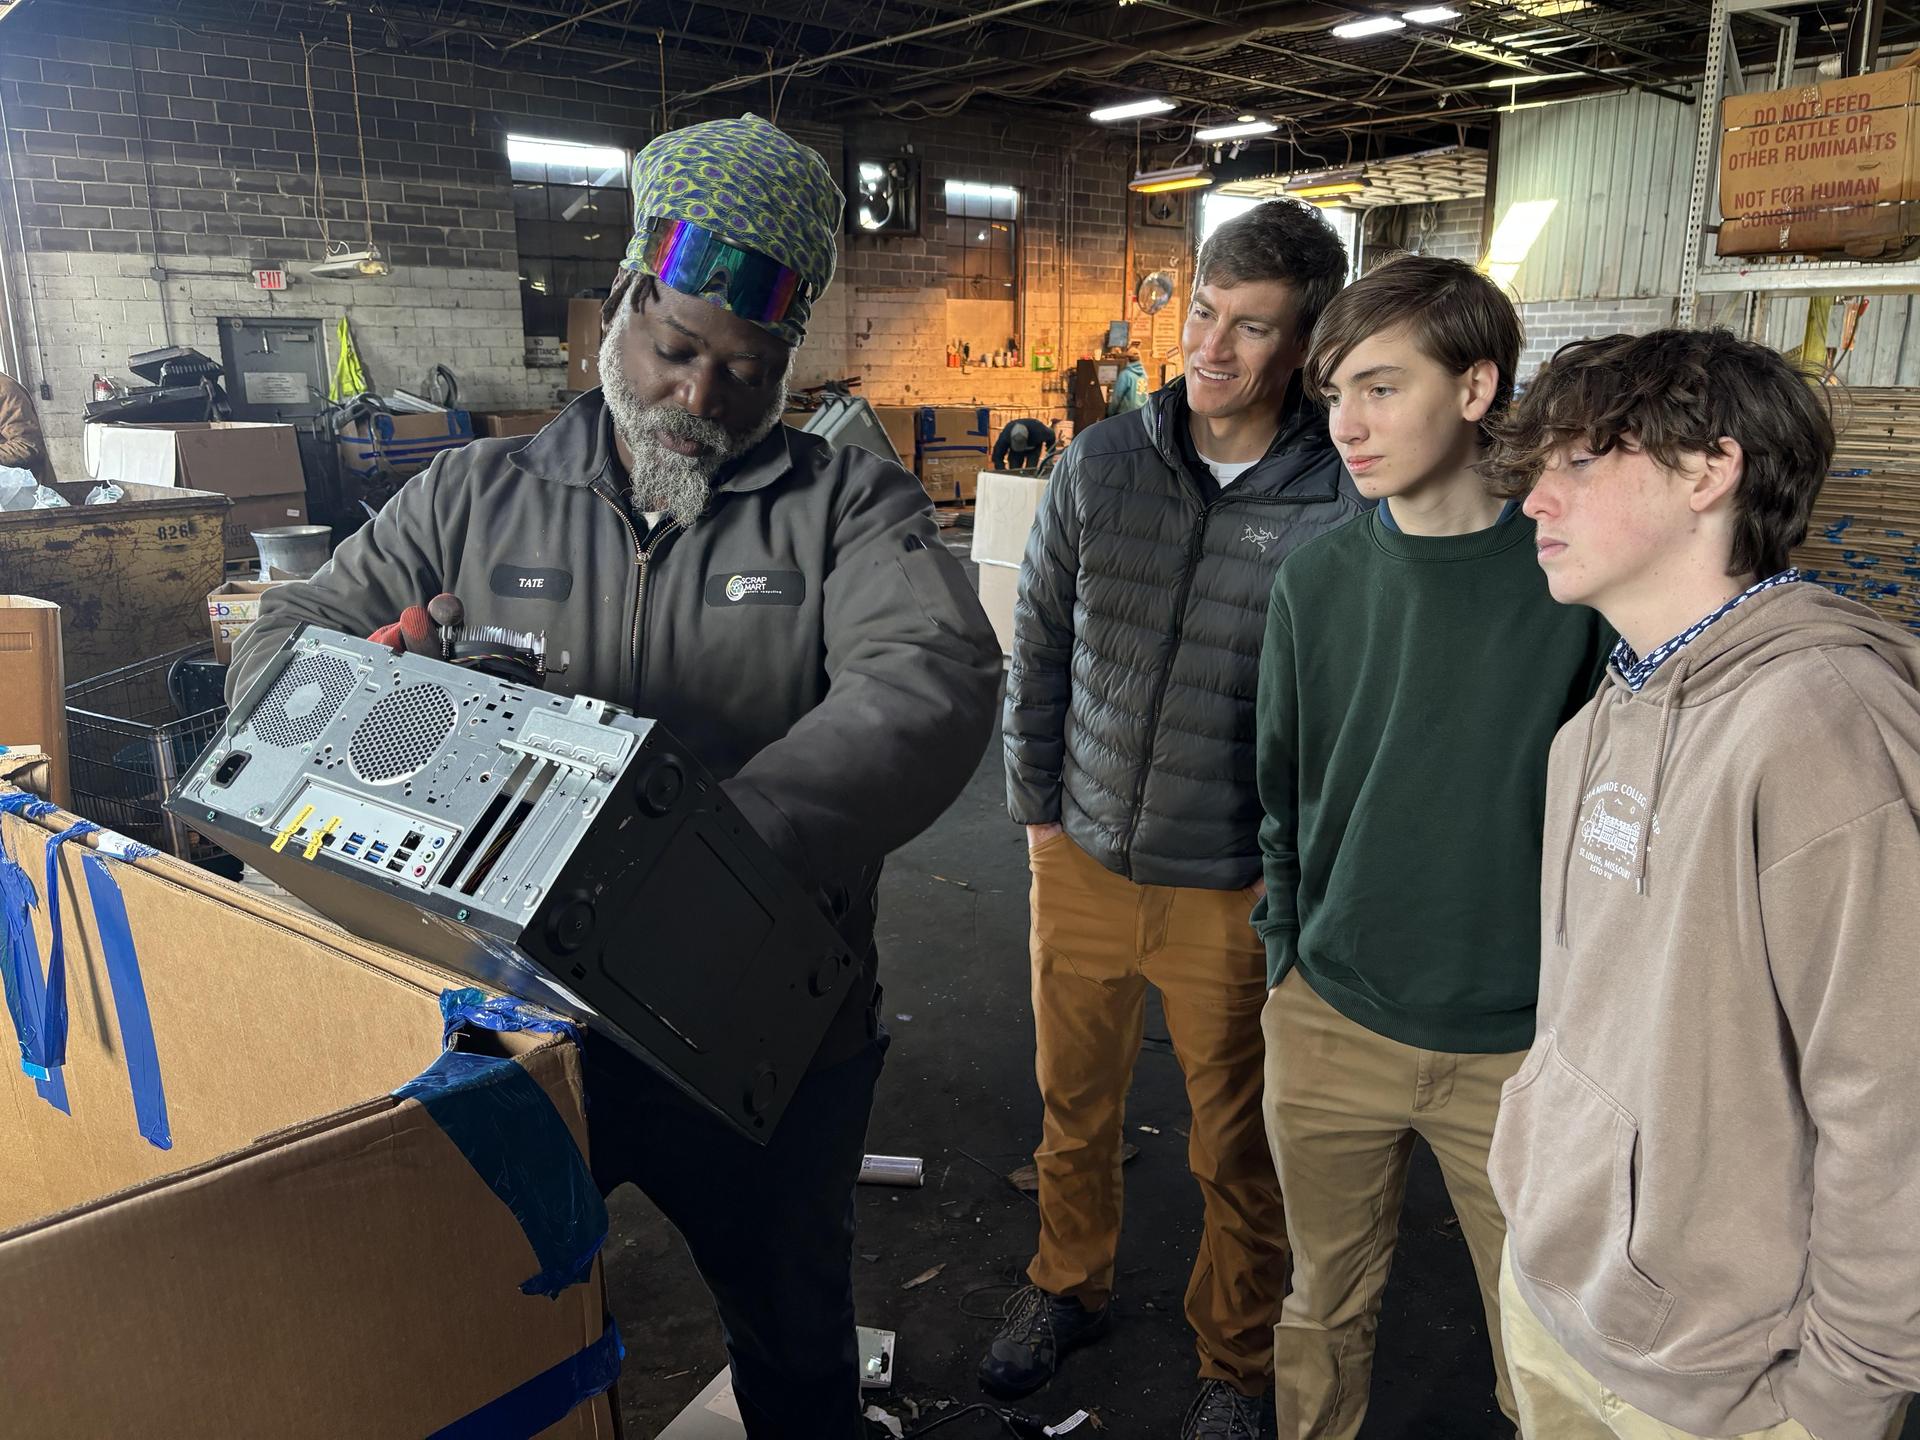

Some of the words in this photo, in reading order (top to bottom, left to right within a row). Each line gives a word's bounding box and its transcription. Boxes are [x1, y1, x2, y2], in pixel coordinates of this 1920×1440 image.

[1754, 108, 1777, 126] DO
[1781, 100, 1818, 122] NOT
[1824, 93, 1871, 117] FEED
[1749, 128, 1770, 147] TO
[1775, 119, 1838, 144] CATTLE
[1845, 114, 1873, 134] OR
[1729, 148, 1778, 171] OTHER
[1784, 131, 1897, 163] RUMINANTS
[1734, 190, 1766, 210] NOT
[1771, 185, 1805, 205] FOR
[1810, 176, 1881, 201] HUMAN
[259, 271, 281, 289] EXIT
[525, 347, 560, 356] MITTANCE
[157, 524, 189, 541] 826
[518, 578, 545, 588] TATE
[741, 576, 768, 585] SCRAP
[208, 602, 250, 619] ebay
[1620, 784, 1648, 810] COLLEG
